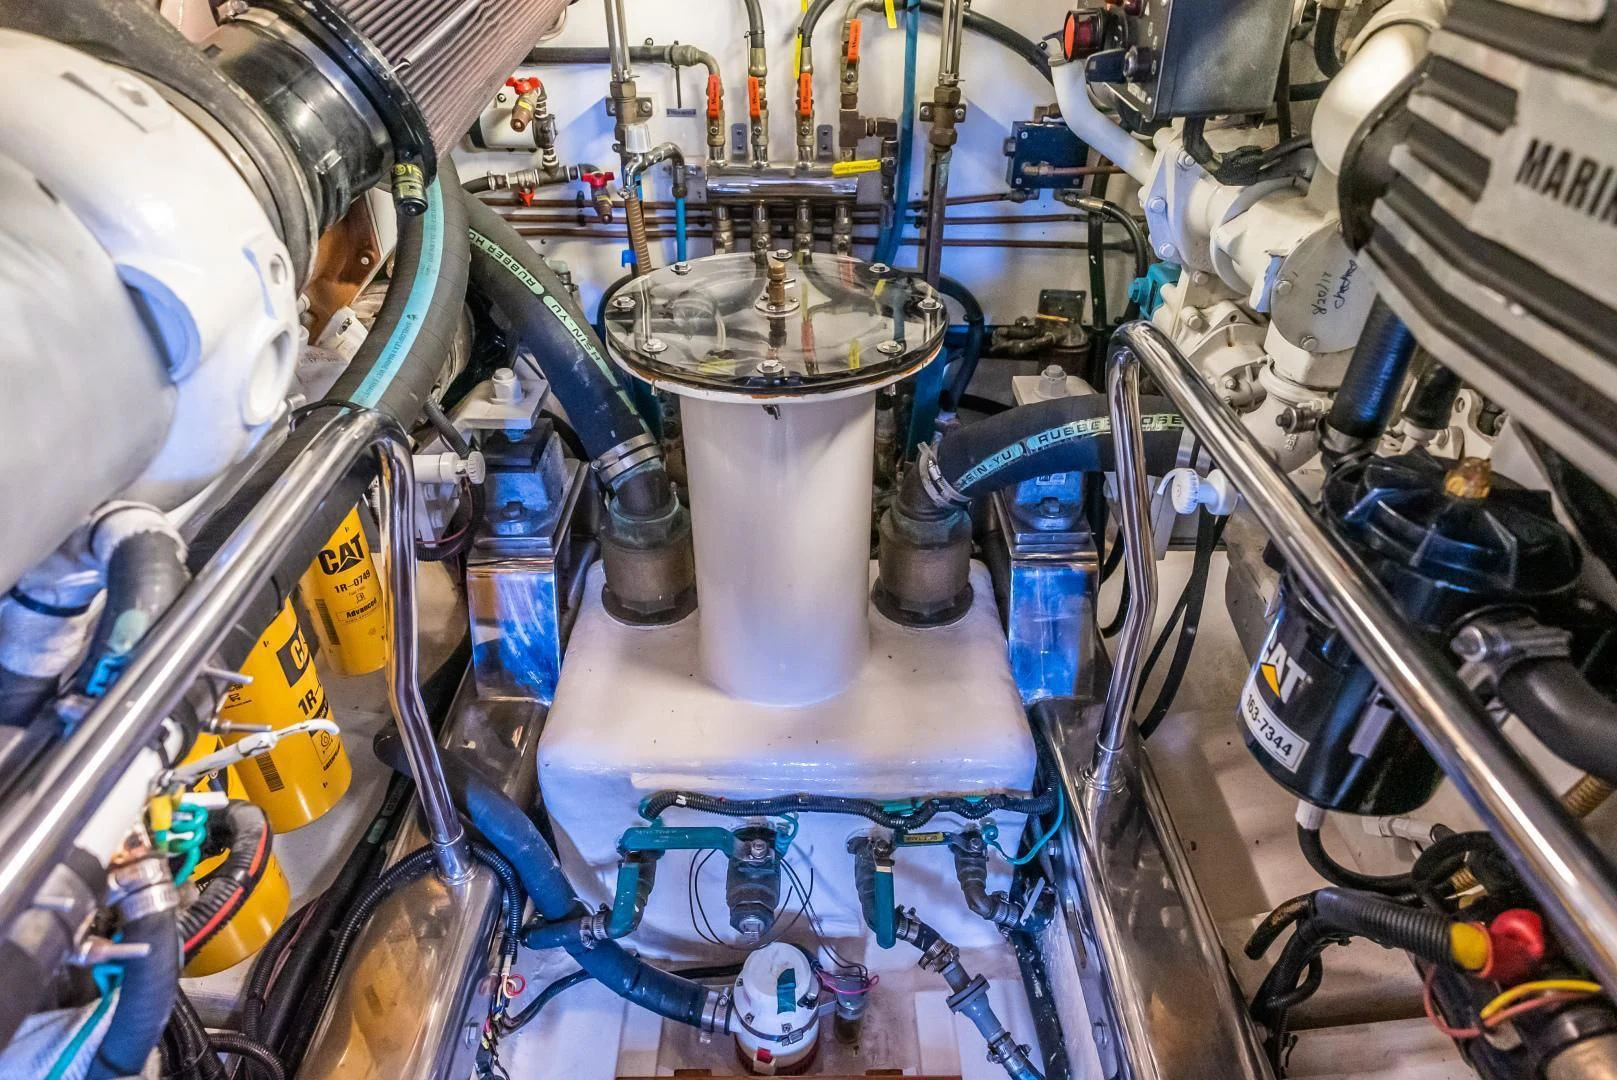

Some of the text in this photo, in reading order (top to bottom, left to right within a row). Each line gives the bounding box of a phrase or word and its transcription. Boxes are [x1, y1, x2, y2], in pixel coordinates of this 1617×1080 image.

[468, 231, 600, 361] HSIN-YU RUBBER HO
[1140, 414, 1183, 426] OSE
[317, 531, 365, 576] CAT
[333, 568, 372, 595] 1R-0749
[1246, 694, 1294, 757] 163-7344
